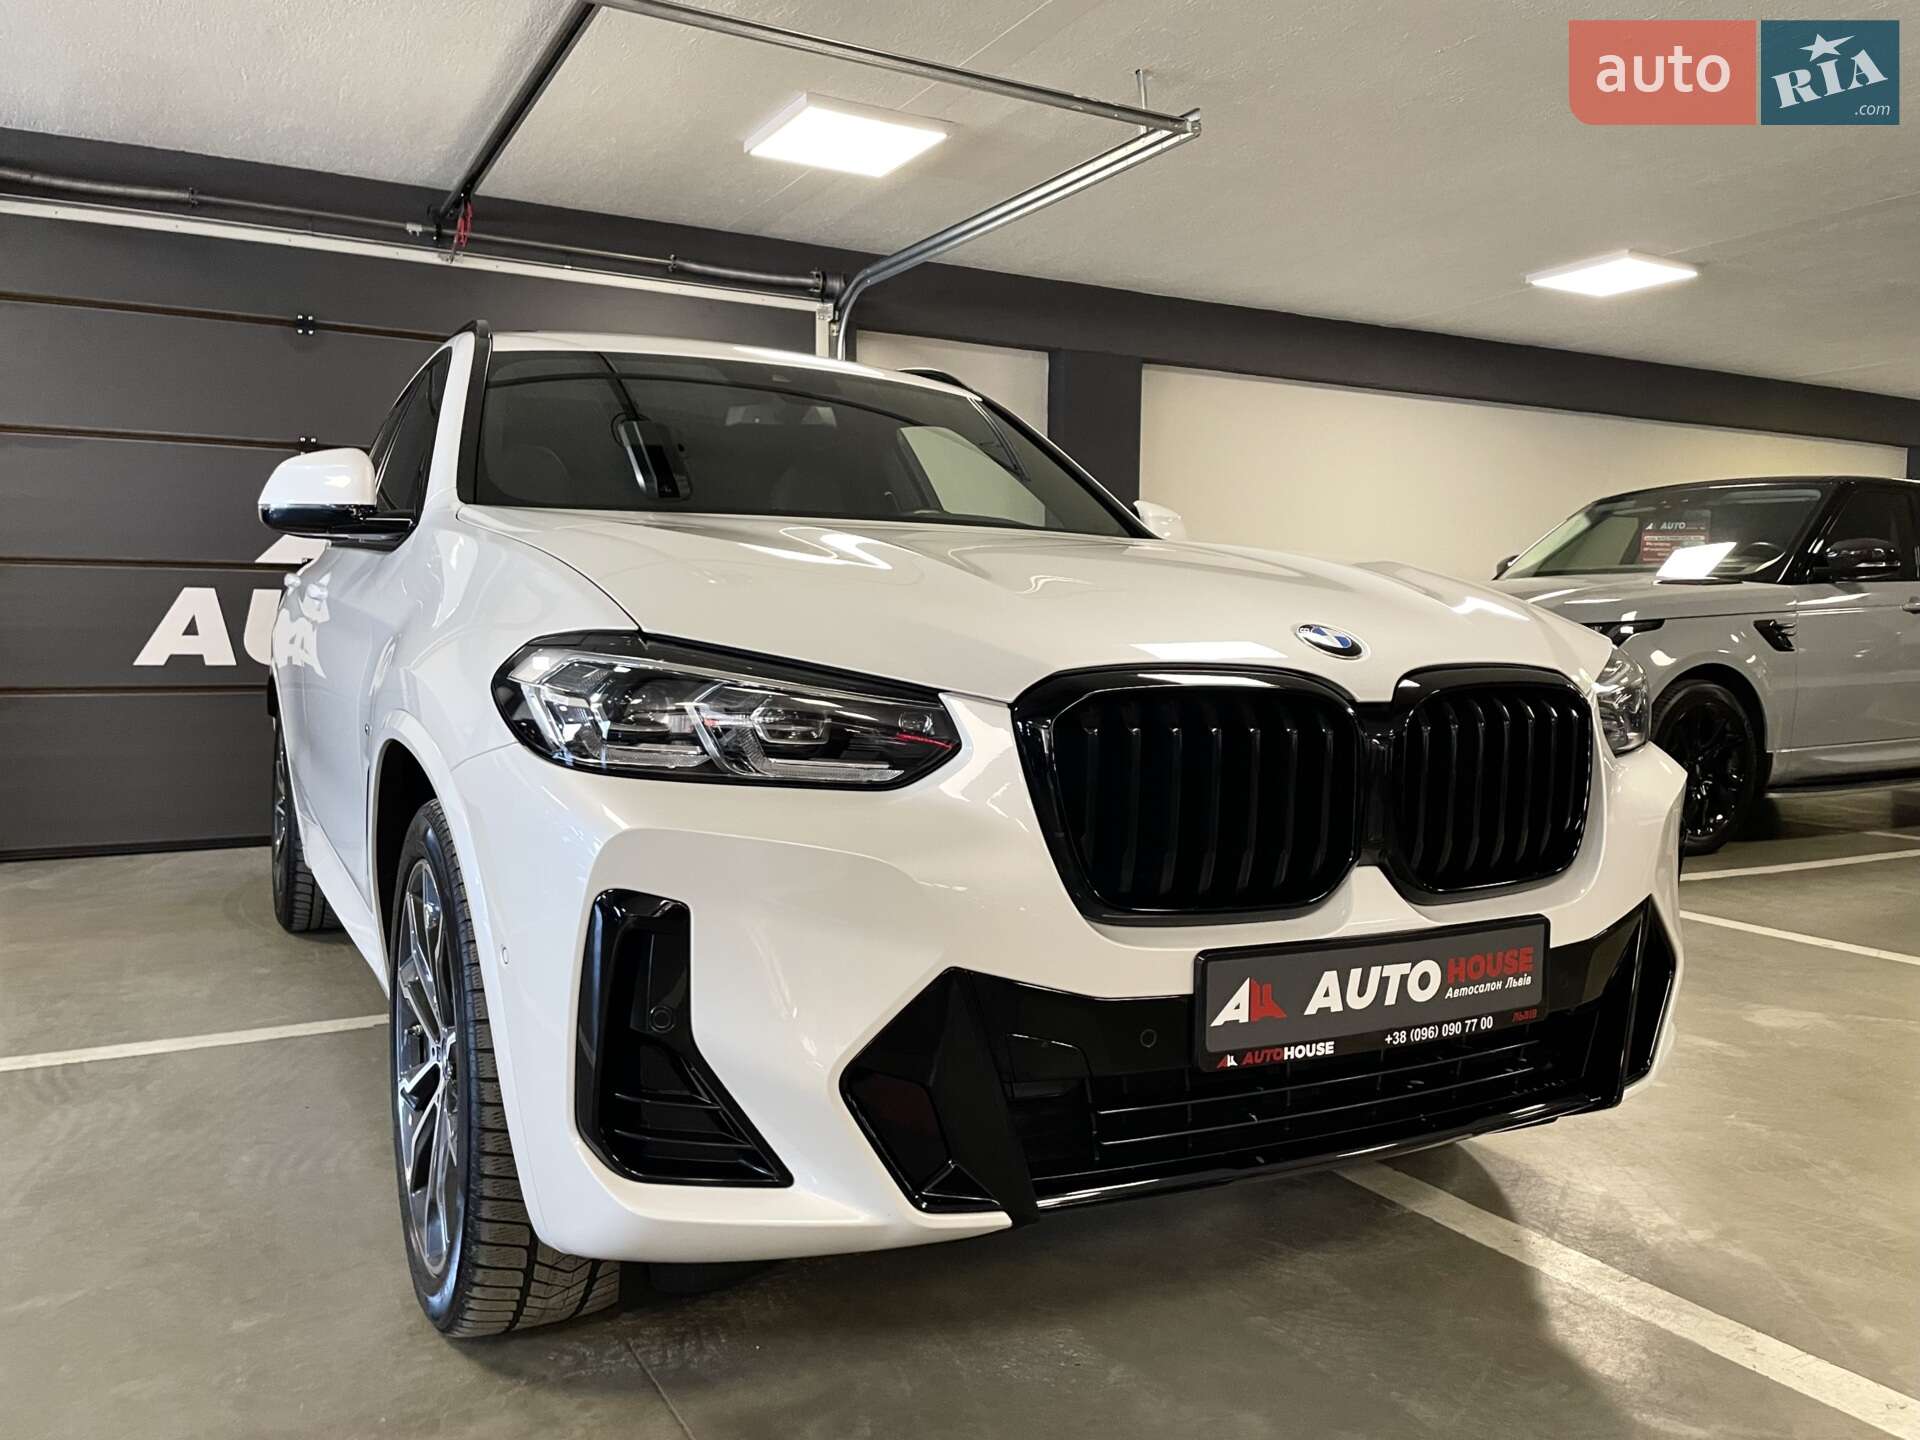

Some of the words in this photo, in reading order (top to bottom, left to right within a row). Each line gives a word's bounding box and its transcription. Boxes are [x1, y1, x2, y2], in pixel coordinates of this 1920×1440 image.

[1660, 522, 1687, 530] AUTO
[1304, 960, 1442, 1016] AUTO
[1447, 947, 1535, 984] HOUSE
[1445, 980, 1503, 1000] Автосалон
[1505, 973, 1533, 989] Львів
[1385, 1030, 1407, 1045] +38
[1410, 1025, 1439, 1043] (096)
[1442, 1021, 1462, 1036] 090
[1465, 1018, 1478, 1033] 77
[1480, 1015, 1494, 1030] 00
